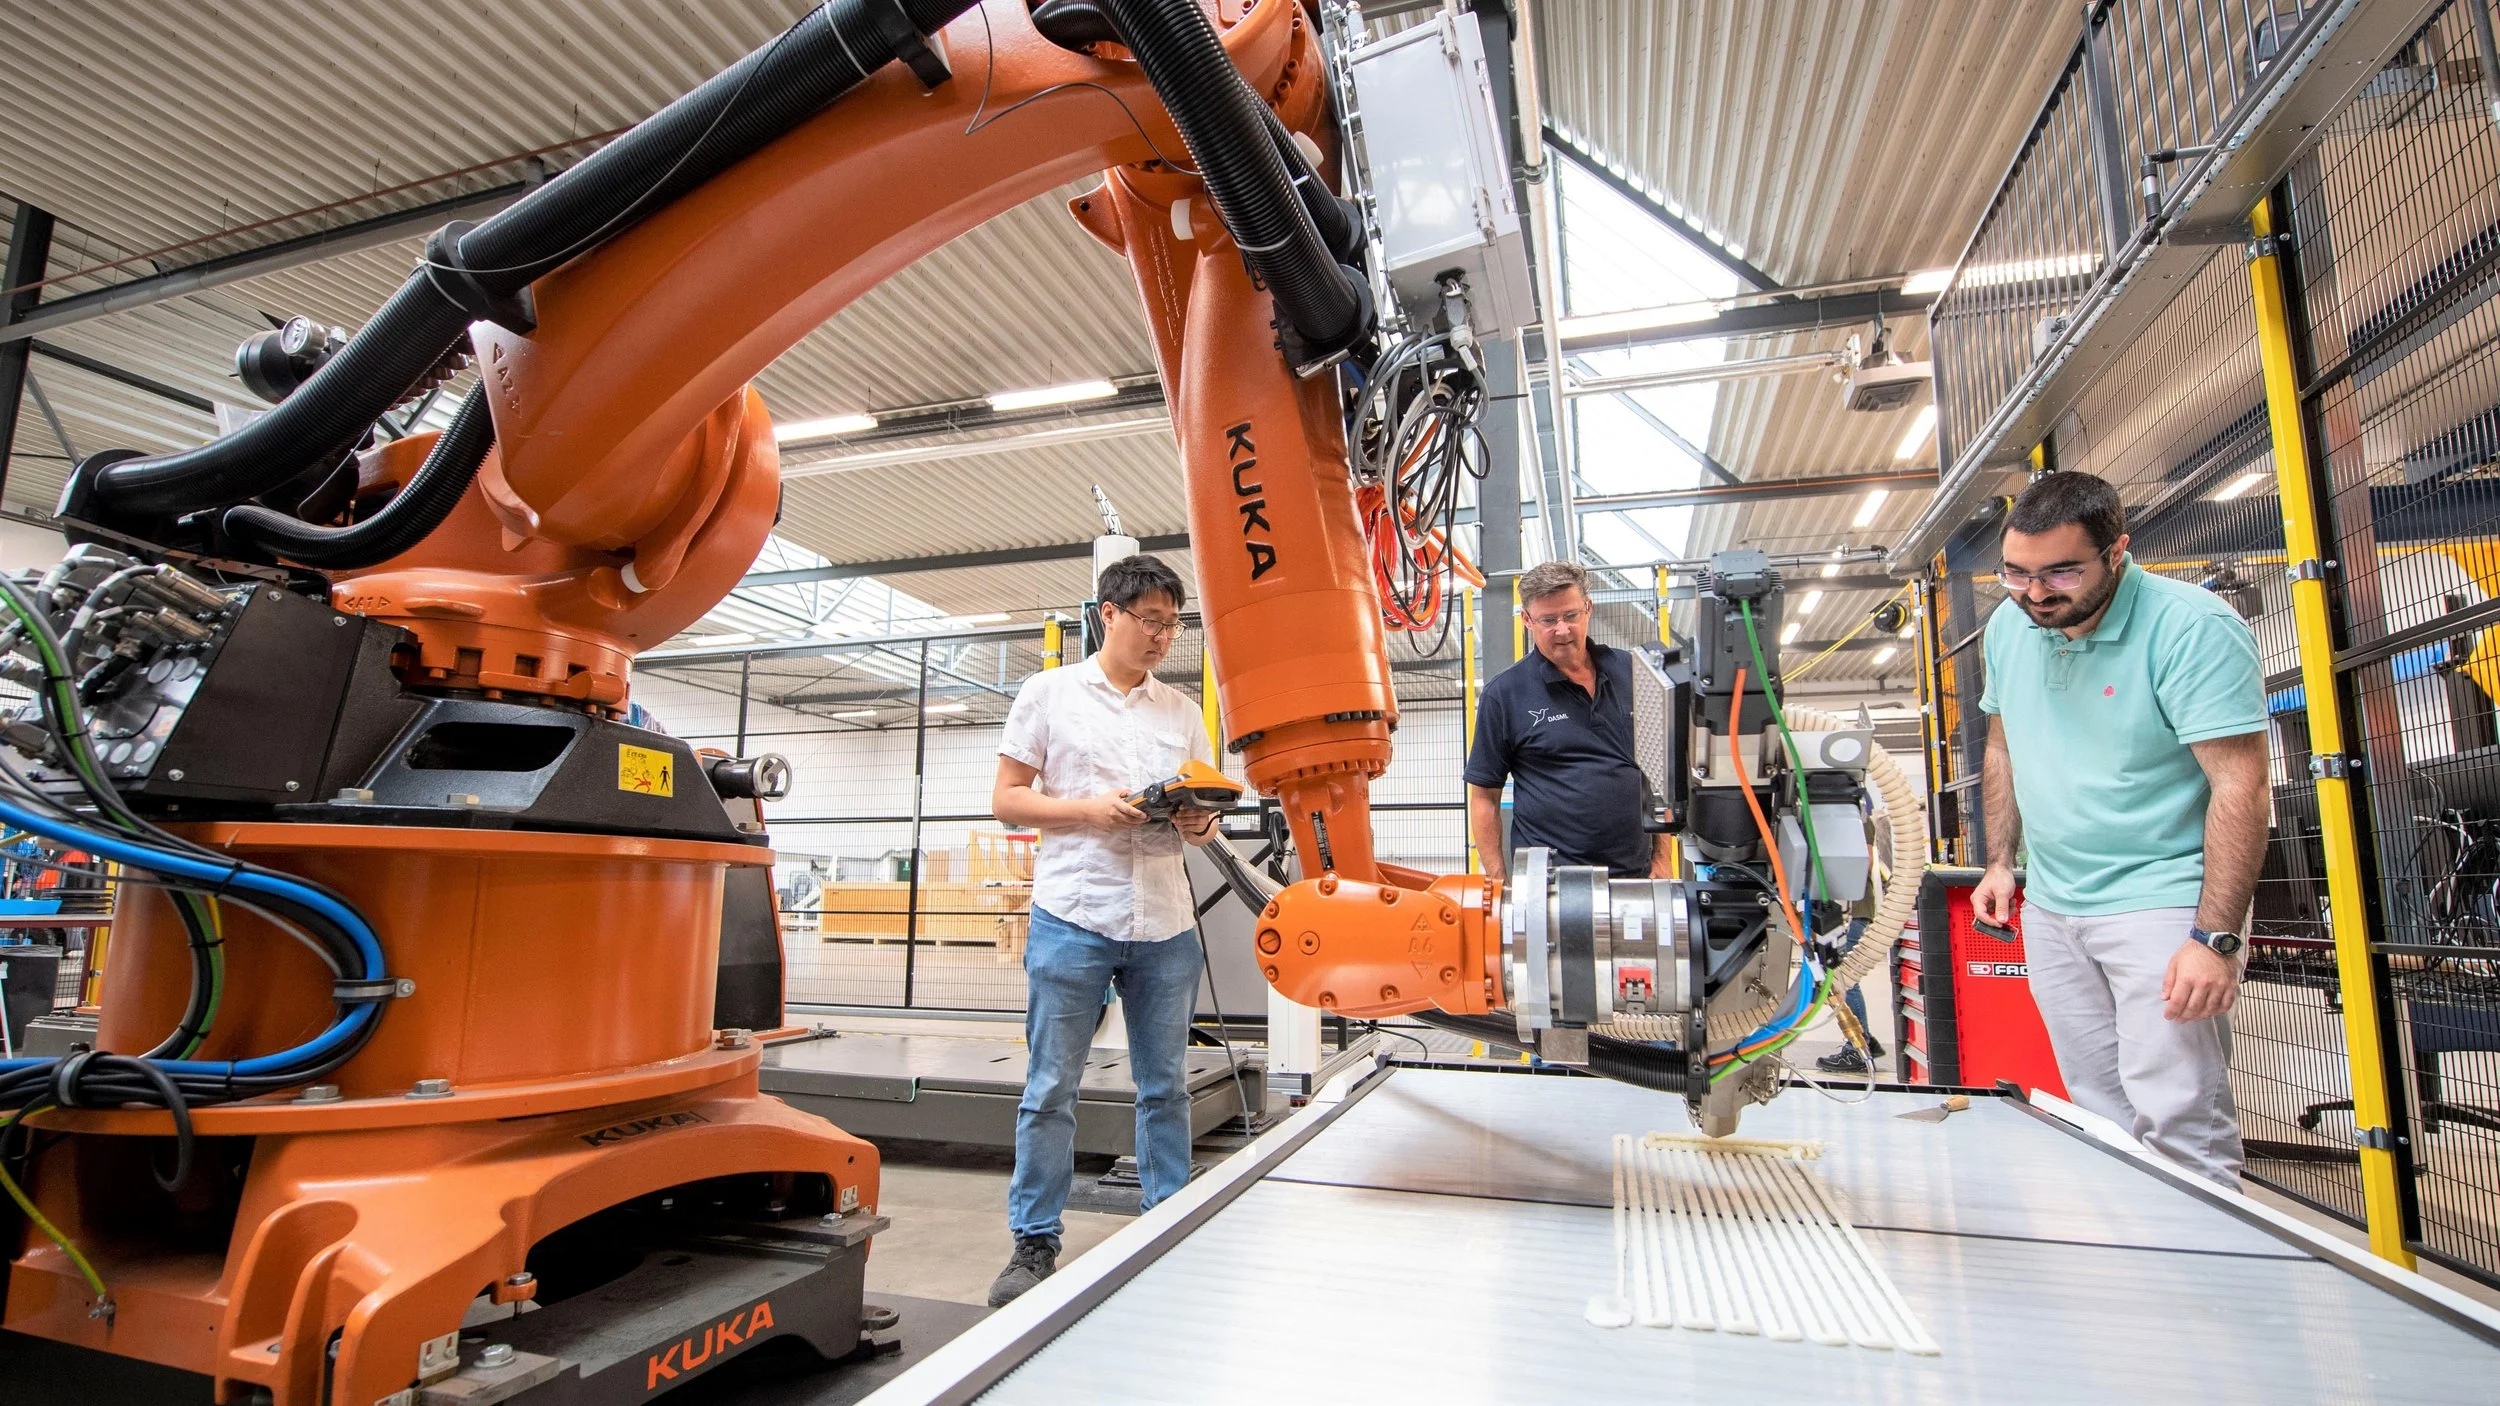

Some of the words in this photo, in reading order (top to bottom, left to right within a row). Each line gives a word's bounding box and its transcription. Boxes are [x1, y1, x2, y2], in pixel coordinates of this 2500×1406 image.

[1225, 421, 1277, 581] KUKA
[580, 1111, 700, 1146] KUKA
[647, 1300, 774, 1391] KUKA
